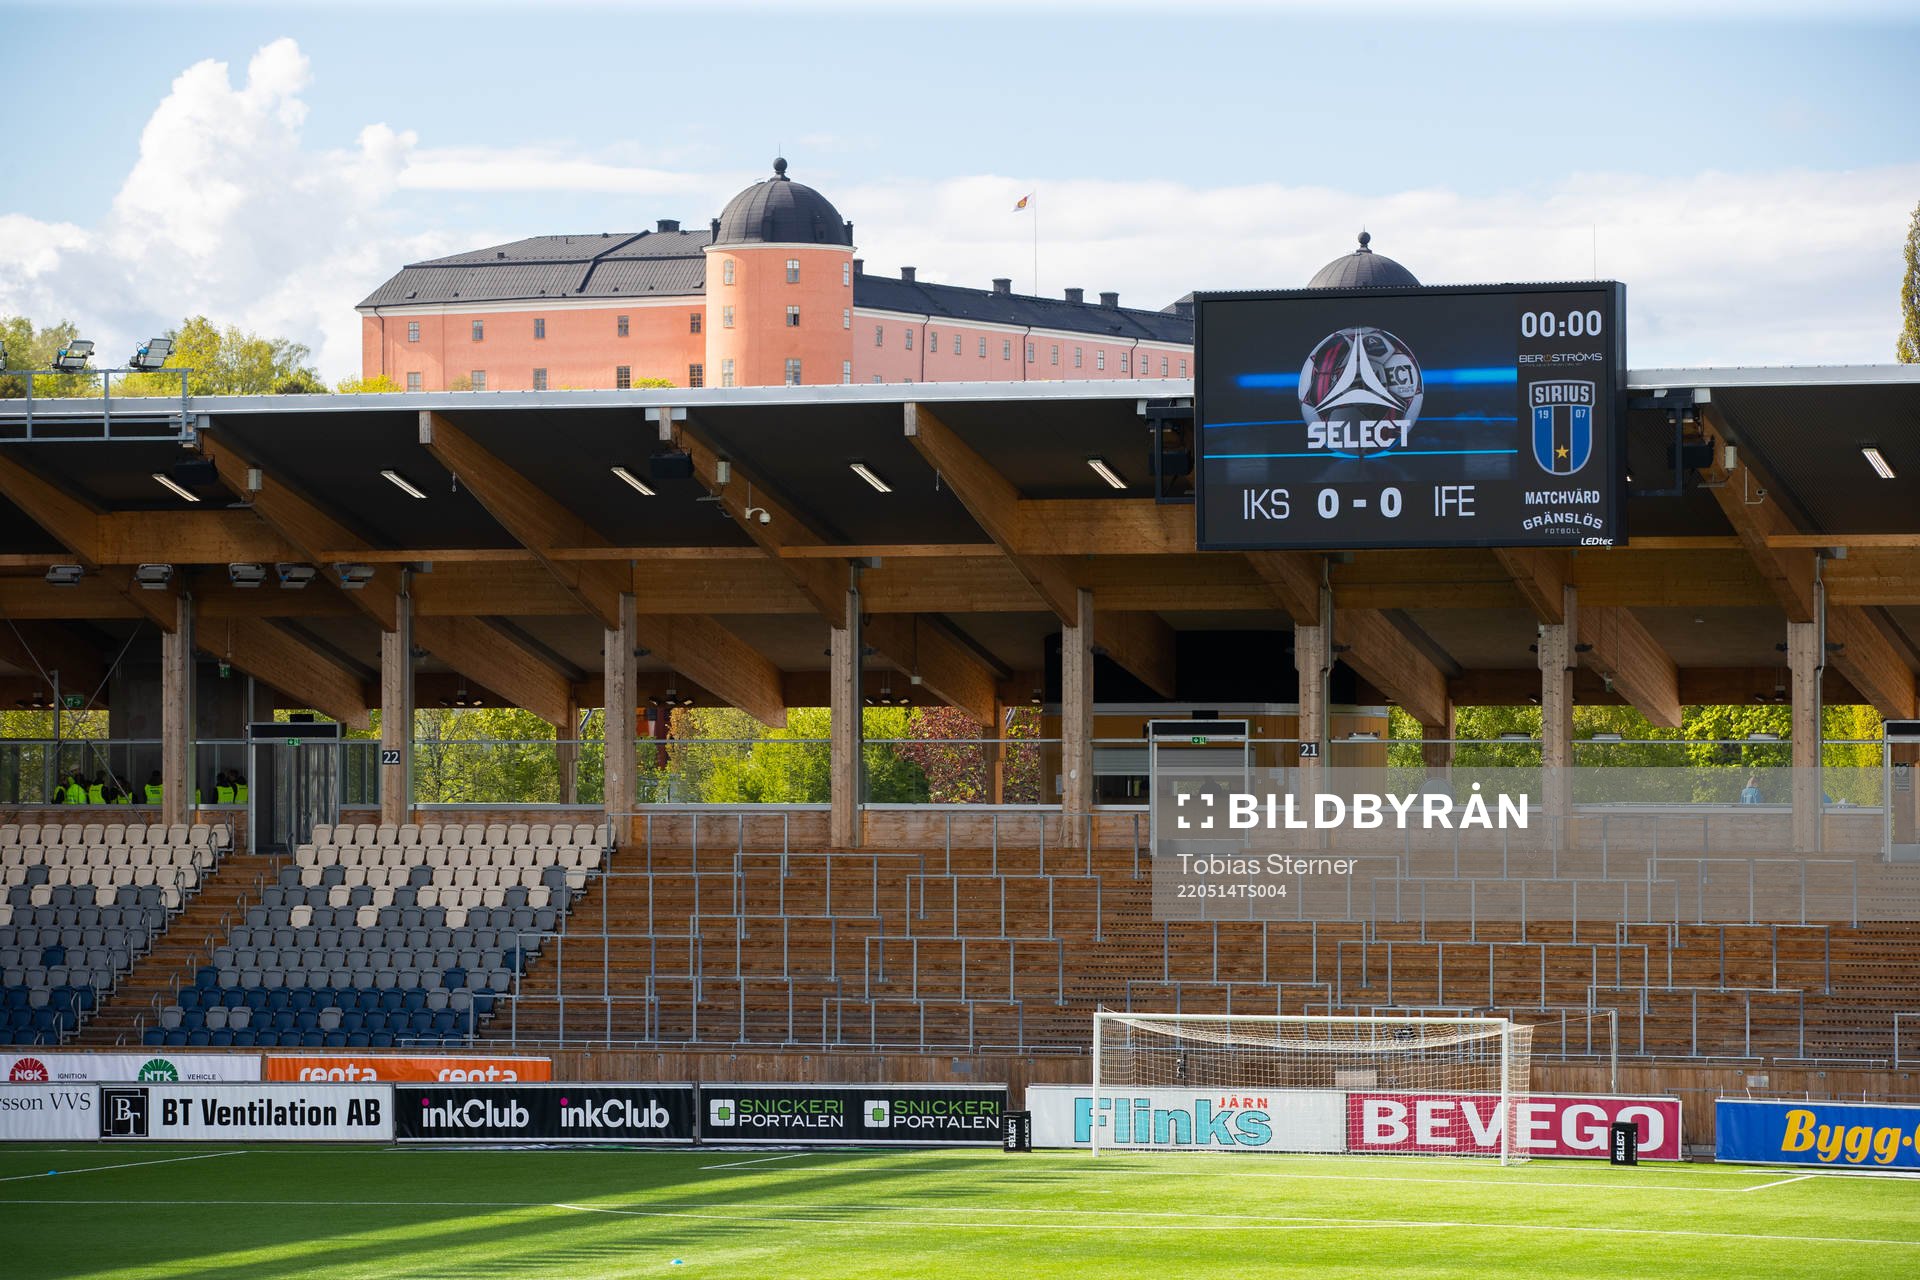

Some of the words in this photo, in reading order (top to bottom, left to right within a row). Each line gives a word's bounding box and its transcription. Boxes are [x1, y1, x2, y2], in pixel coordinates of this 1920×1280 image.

[1521, 310, 1602, 338] 00:00
[1535, 384, 1590, 403] SIRIUS
[1537, 409, 1549, 419] 19
[1575, 409, 1586, 418] 07
[1307, 419, 1411, 449] SELECT
[1243, 488, 1290, 520] IKS
[1317, 488, 1340, 519] 0
[1380, 487, 1402, 518] 0
[1434, 485, 1476, 517] IFE
[1525, 488, 1600, 504] MATCHVÄRD
[1522, 511, 1603, 531] GRÄNSLÖS
[1581, 537, 1614, 546] LEDtec
[383, 751, 400, 764] 22
[1301, 743, 1318, 756] 21
[15, 1069, 42, 1081] NGK
[144, 1070, 173, 1082] NTK
[0, 1097, 43, 1110] sson
[49, 1092, 91, 1111] VVS
[739, 1099, 844, 1114] SNICKERI
[893, 1100, 1000, 1115] SNICKERI
[1218, 1094, 1269, 1109] JÄRN
[162, 1099, 193, 1126] BT
[199, 1099, 337, 1126] Ventilation
[346, 1099, 381, 1126] AB
[422, 1097, 530, 1128] inkClub
[560, 1097, 670, 1129] inkClub
[739, 1115, 844, 1128] PORTALEN
[1073, 1097, 1273, 1147] Flinks
[893, 1116, 1000, 1129] PORTALEN
[1362, 1099, 1665, 1153] BEVEGO
[1008, 1118, 1017, 1149] SELECT
[1780, 1108, 1920, 1165] Bygg·
[1616, 1130, 1625, 1161] SELECT
